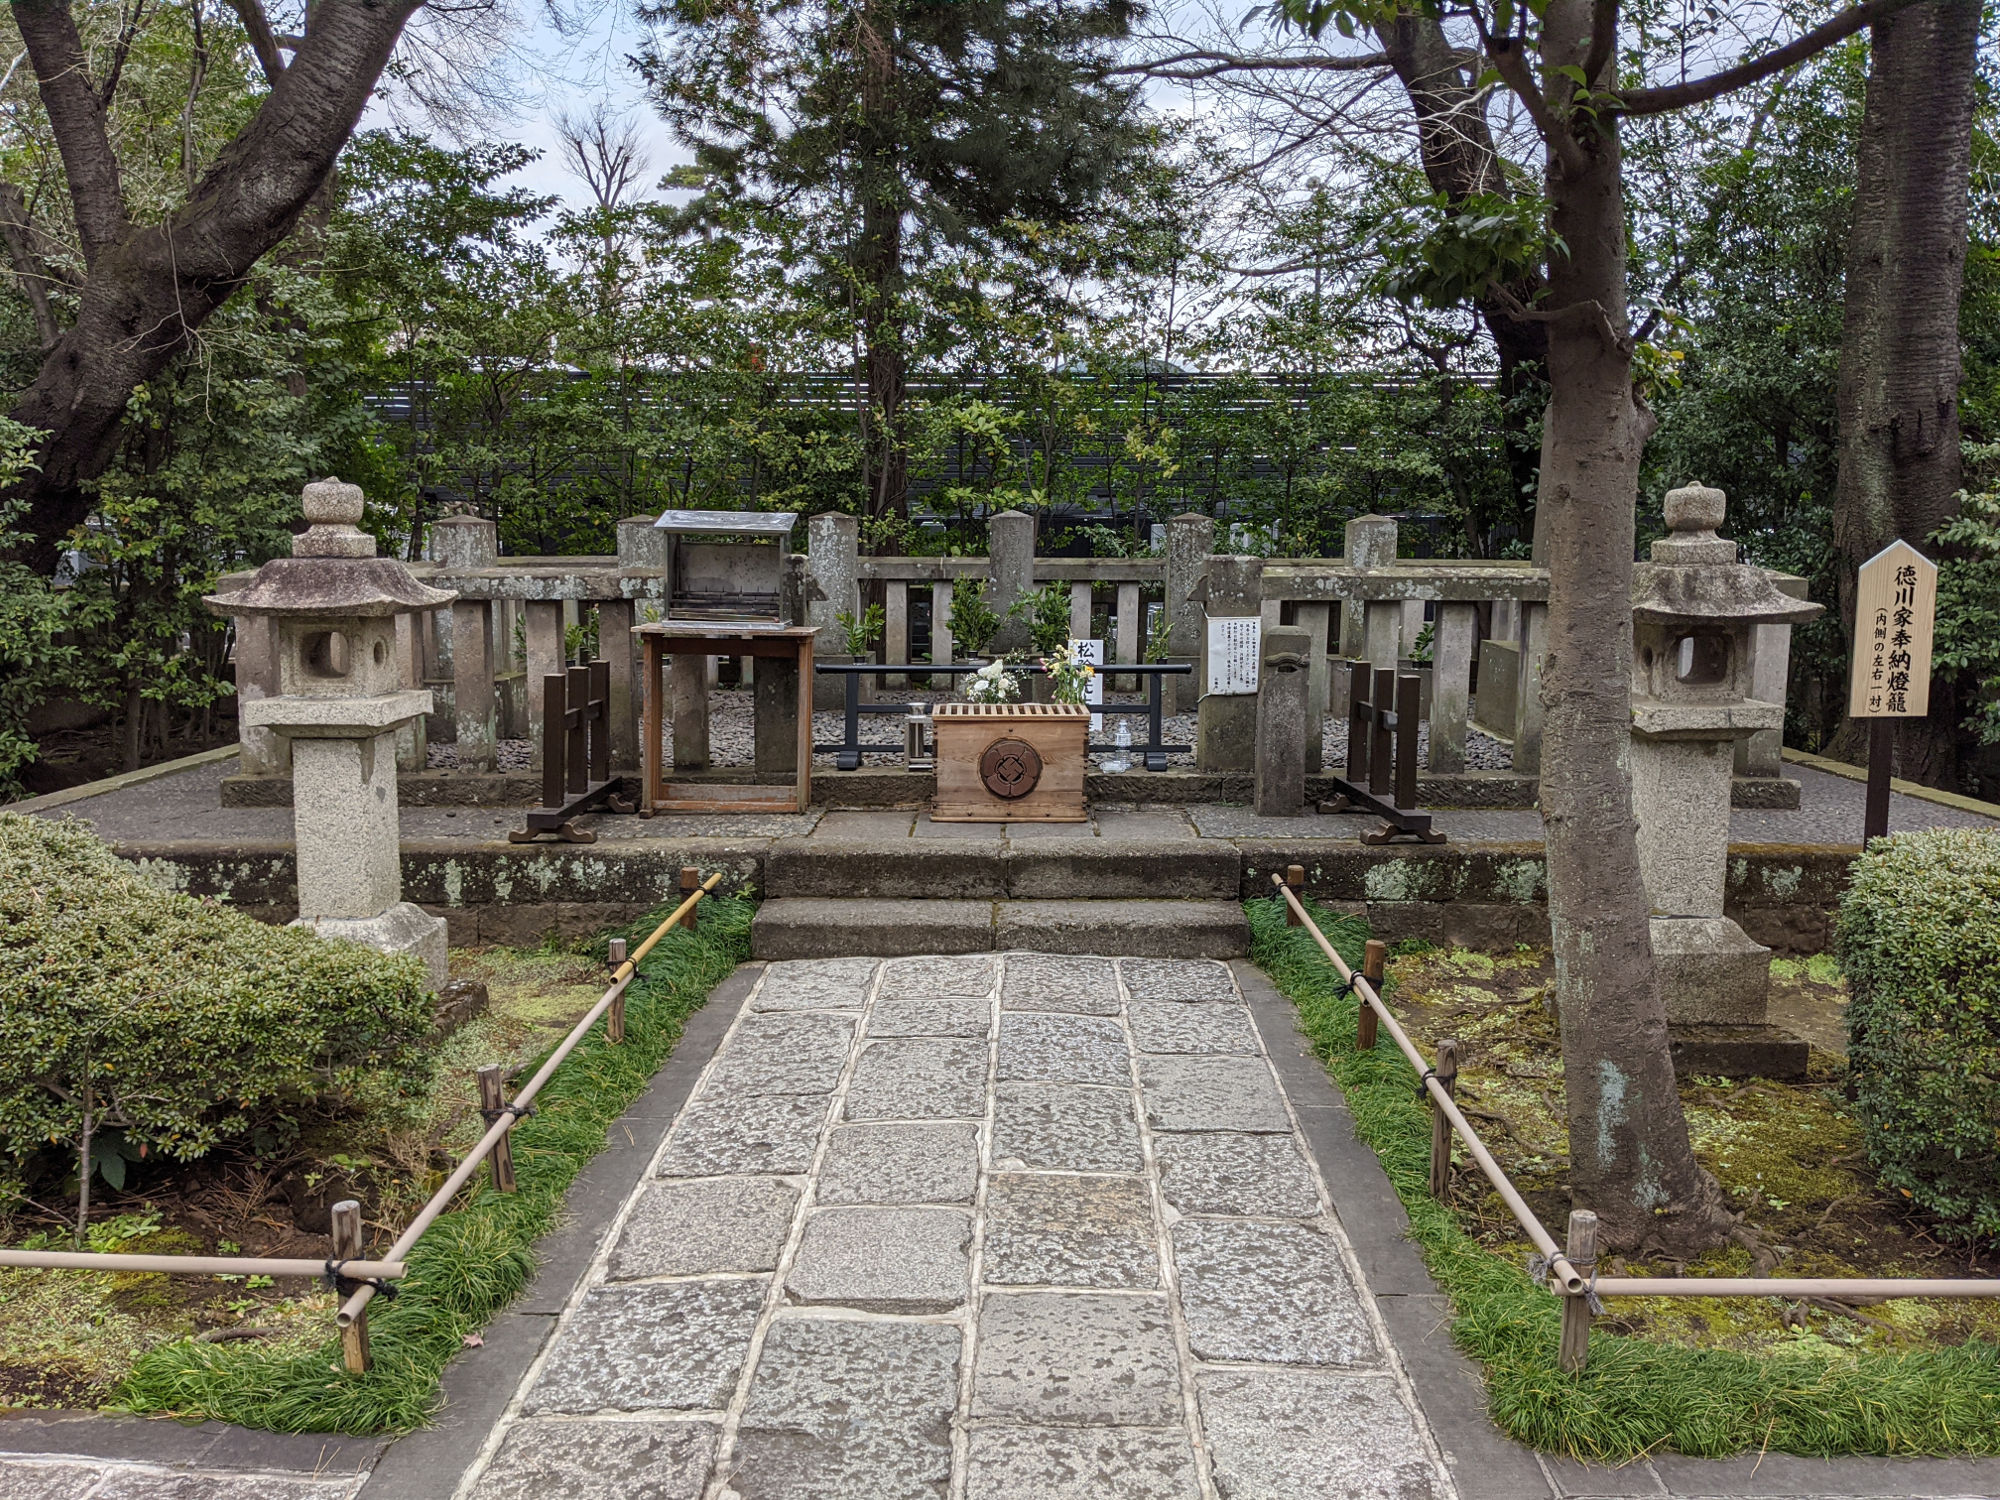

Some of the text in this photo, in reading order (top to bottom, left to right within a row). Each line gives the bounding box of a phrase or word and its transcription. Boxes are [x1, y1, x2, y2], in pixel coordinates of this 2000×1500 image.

[1886, 564, 1917, 713] 徳川家奉納燈籠
